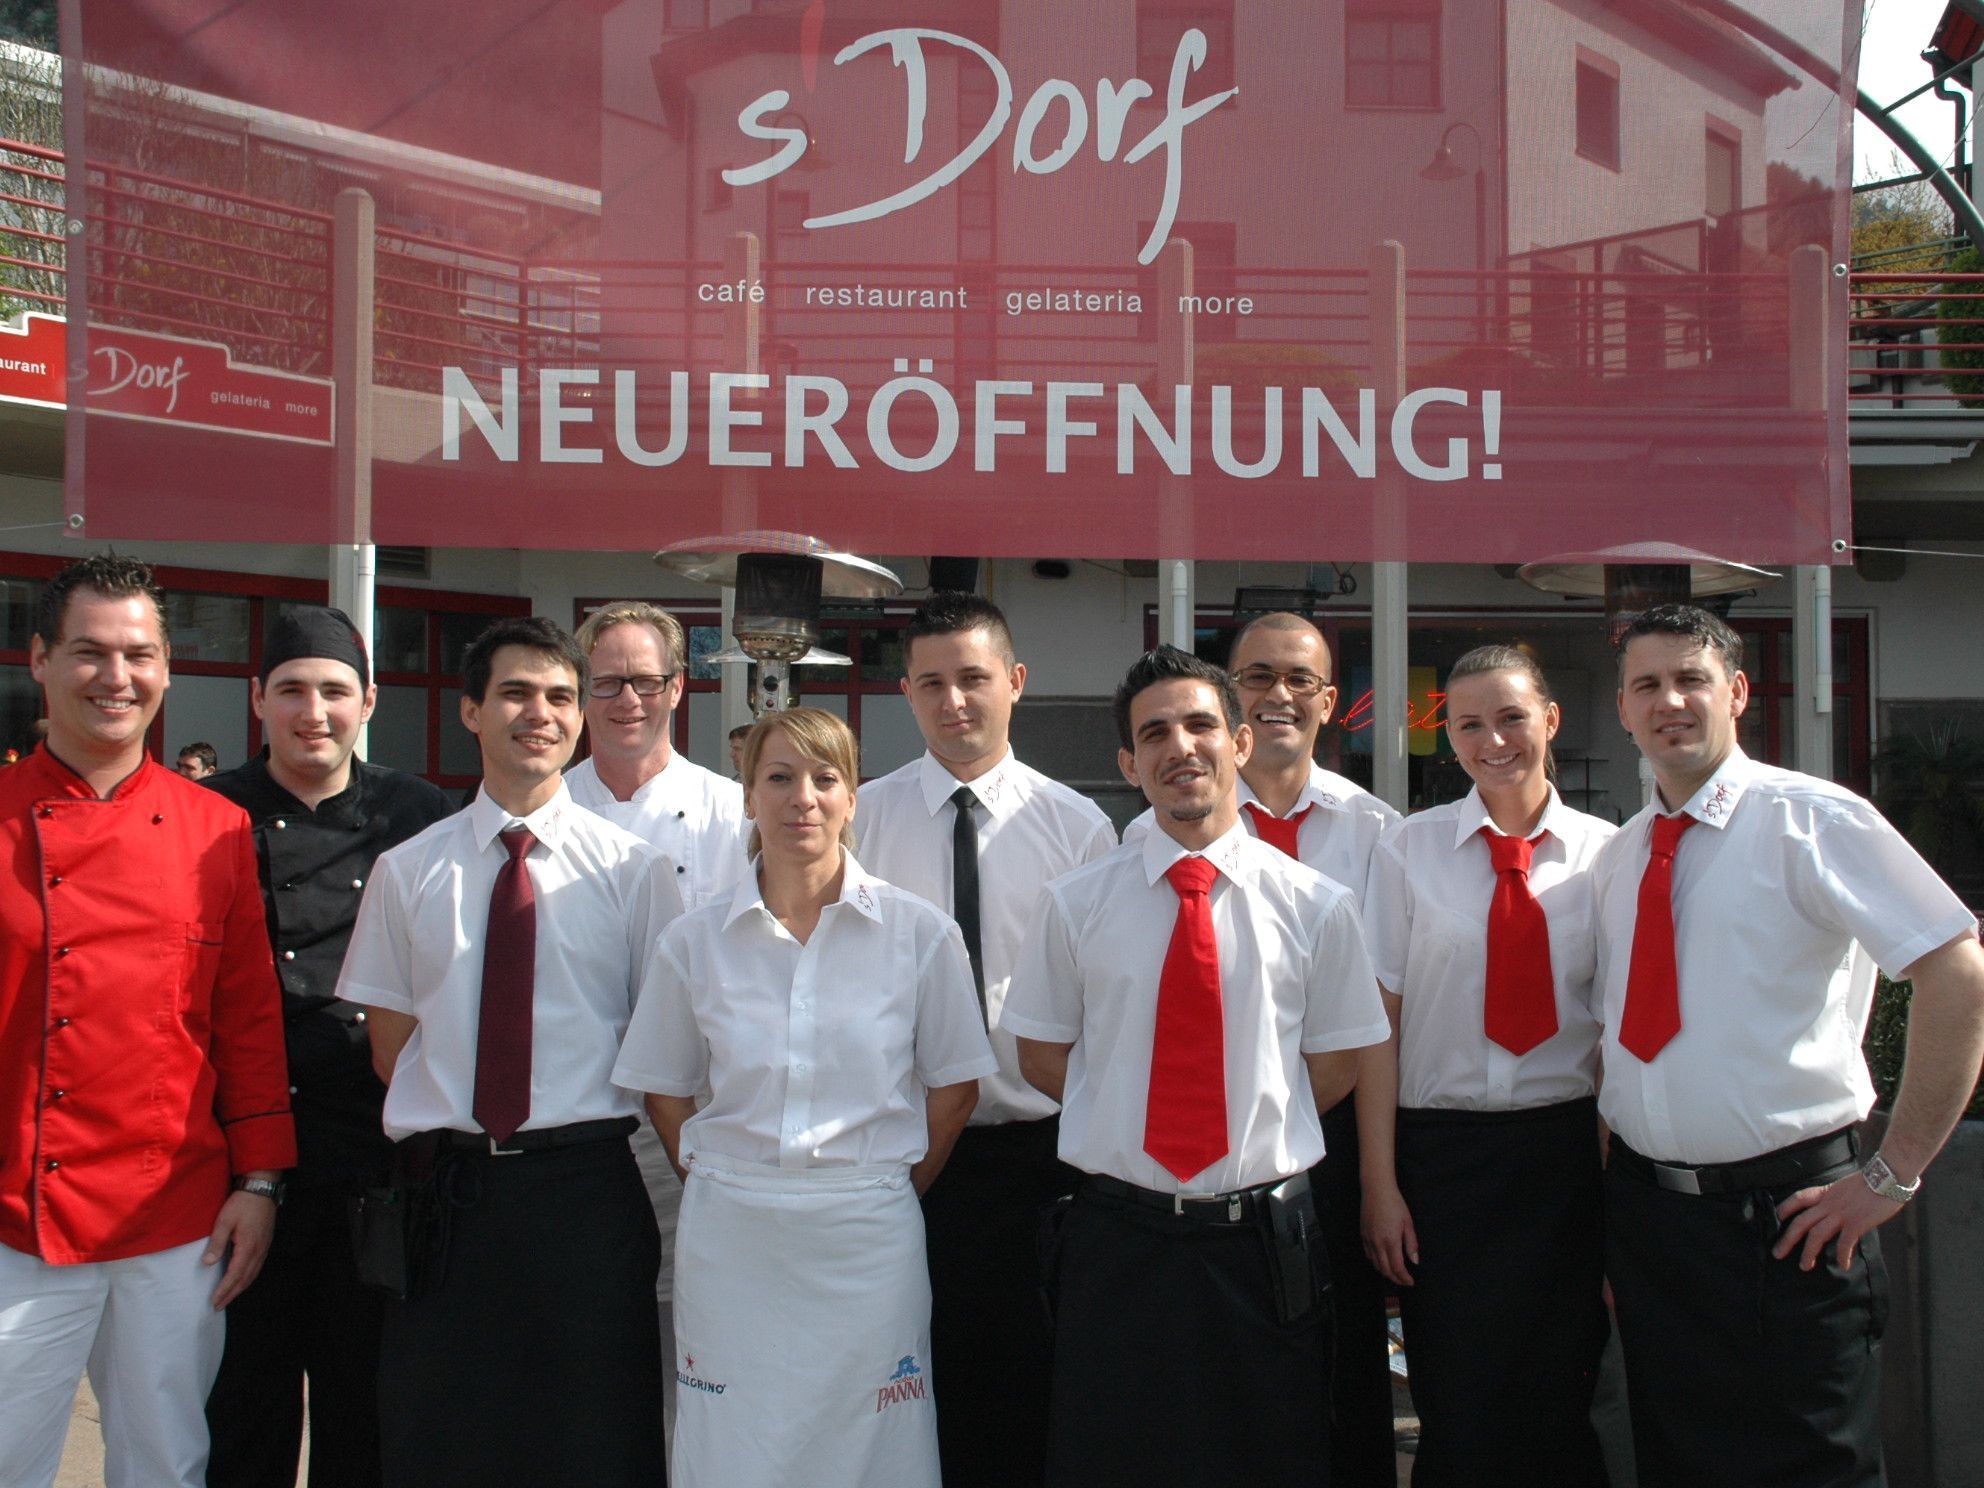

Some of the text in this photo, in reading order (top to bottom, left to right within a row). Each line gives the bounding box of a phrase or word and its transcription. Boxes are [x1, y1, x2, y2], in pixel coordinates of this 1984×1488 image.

[697, 279, 1254, 315] café restaurant gelateria more
[210, 389, 318, 416] gelateria more
[442, 358, 1503, 481] NEUERÖFFNUNG!
[876, 1376, 926, 1413] PANNA
